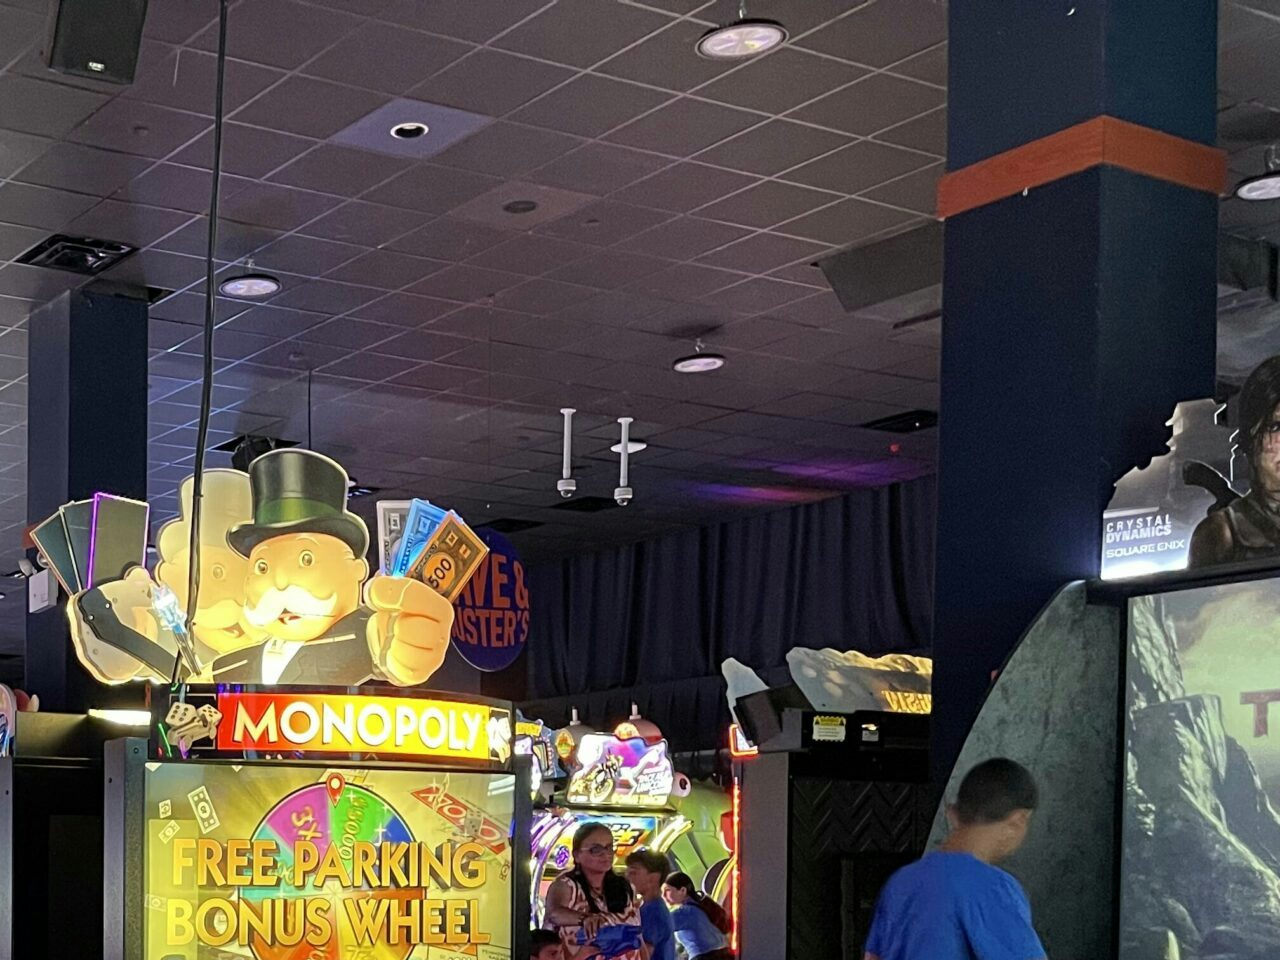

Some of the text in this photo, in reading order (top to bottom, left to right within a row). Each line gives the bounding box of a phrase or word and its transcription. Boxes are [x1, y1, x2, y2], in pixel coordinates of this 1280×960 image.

[1106, 514, 1172, 533] CRYSTAL
[1106, 525, 1172, 543] DYNAMICS
[1106, 539, 1185, 558] SQUARE ENIX
[514, 560, 530, 609] &
[452, 608, 530, 648] USTER'S
[232, 701, 482, 751] MONOPOLY
[171, 838, 487, 888] FREE PARKING
[166, 898, 492, 946] BONUS WHEEL
